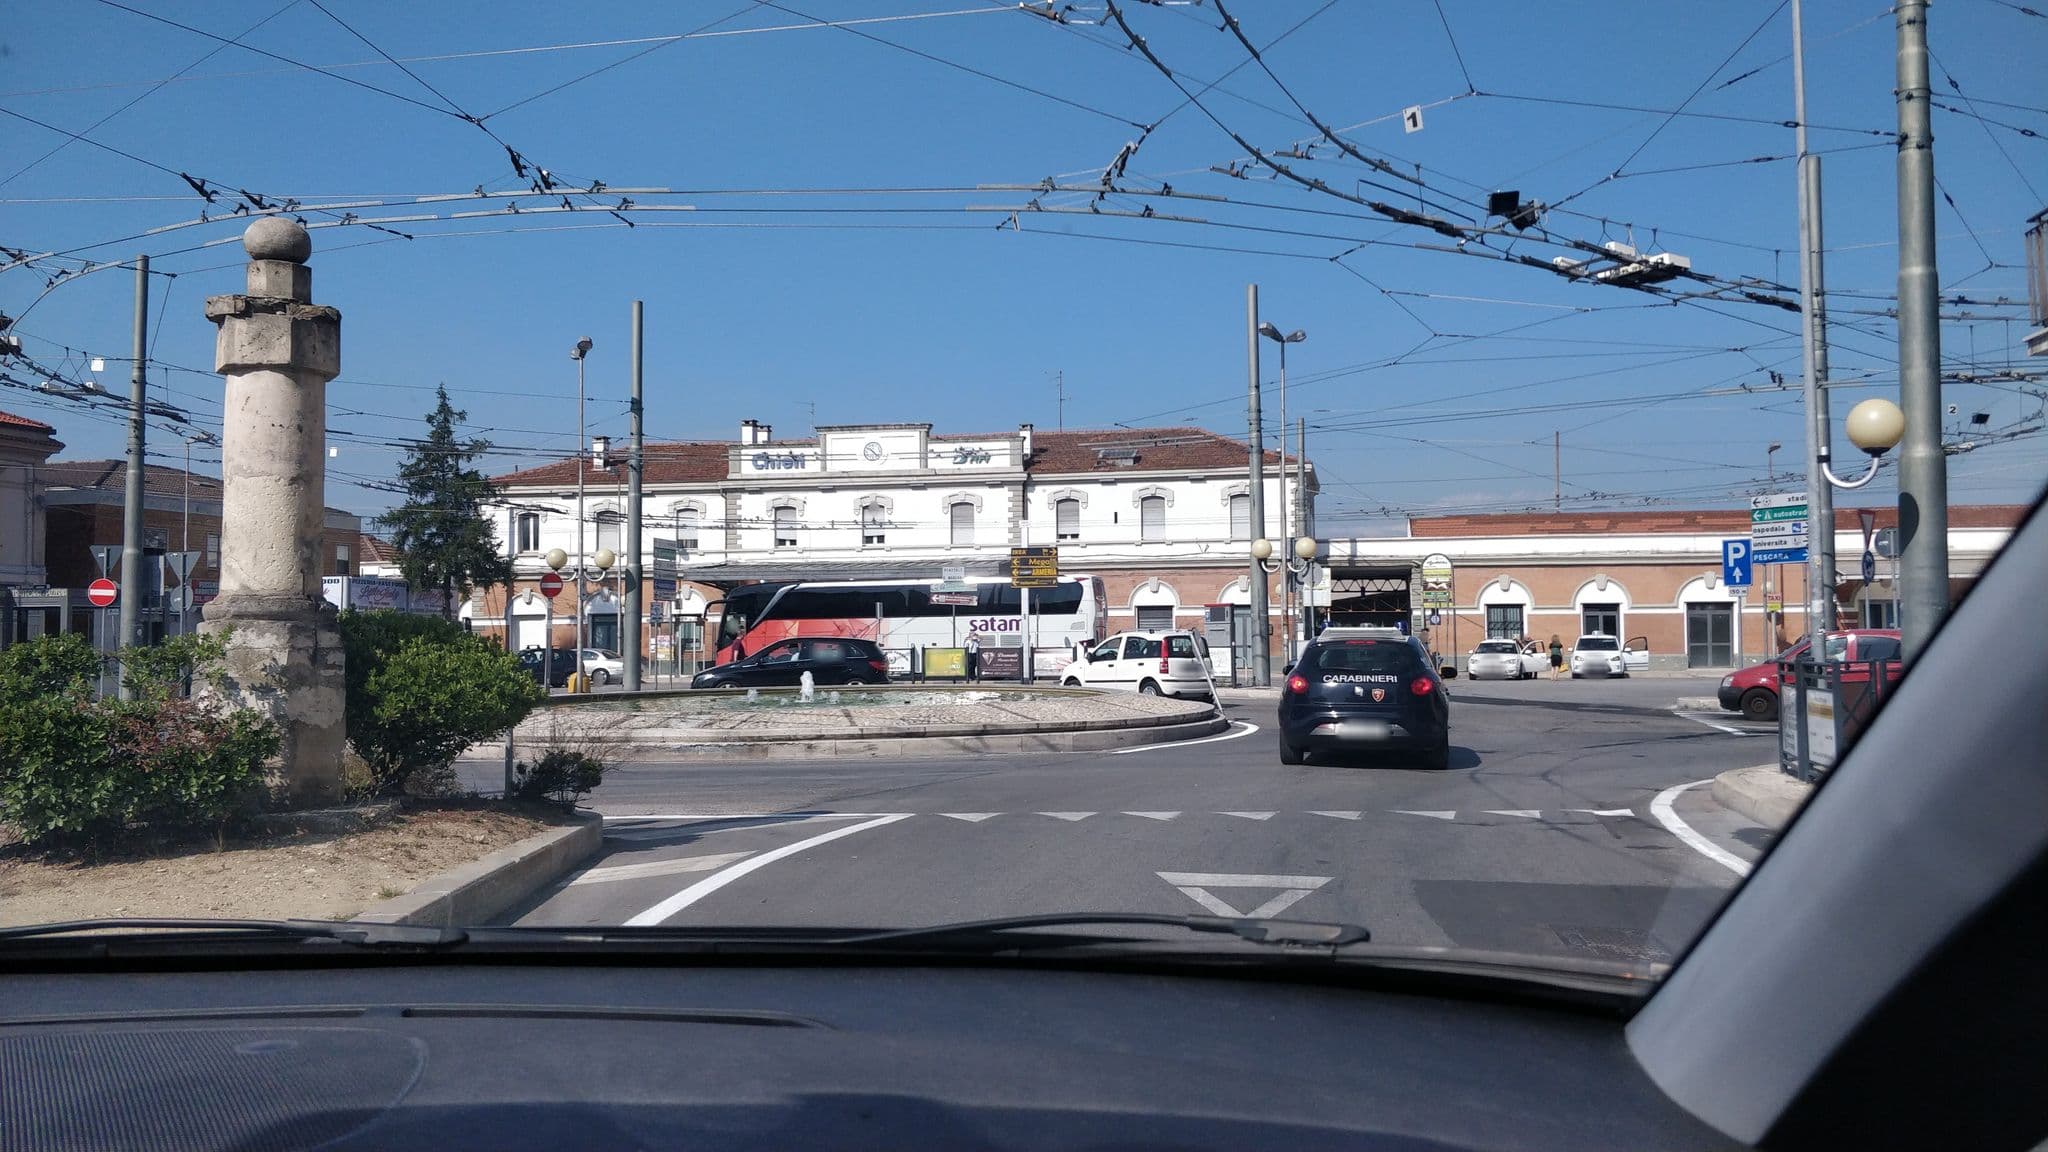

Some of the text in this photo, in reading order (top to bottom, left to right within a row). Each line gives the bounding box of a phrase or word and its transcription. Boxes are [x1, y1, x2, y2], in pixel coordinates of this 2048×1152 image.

[1407, 111, 1418, 128] 1
[1949, 406, 1957, 414] 2
[1753, 525, 1786, 534] ospedale
[1728, 543, 1746, 567] P
[1322, 674, 1398, 683] CARABINIERI
